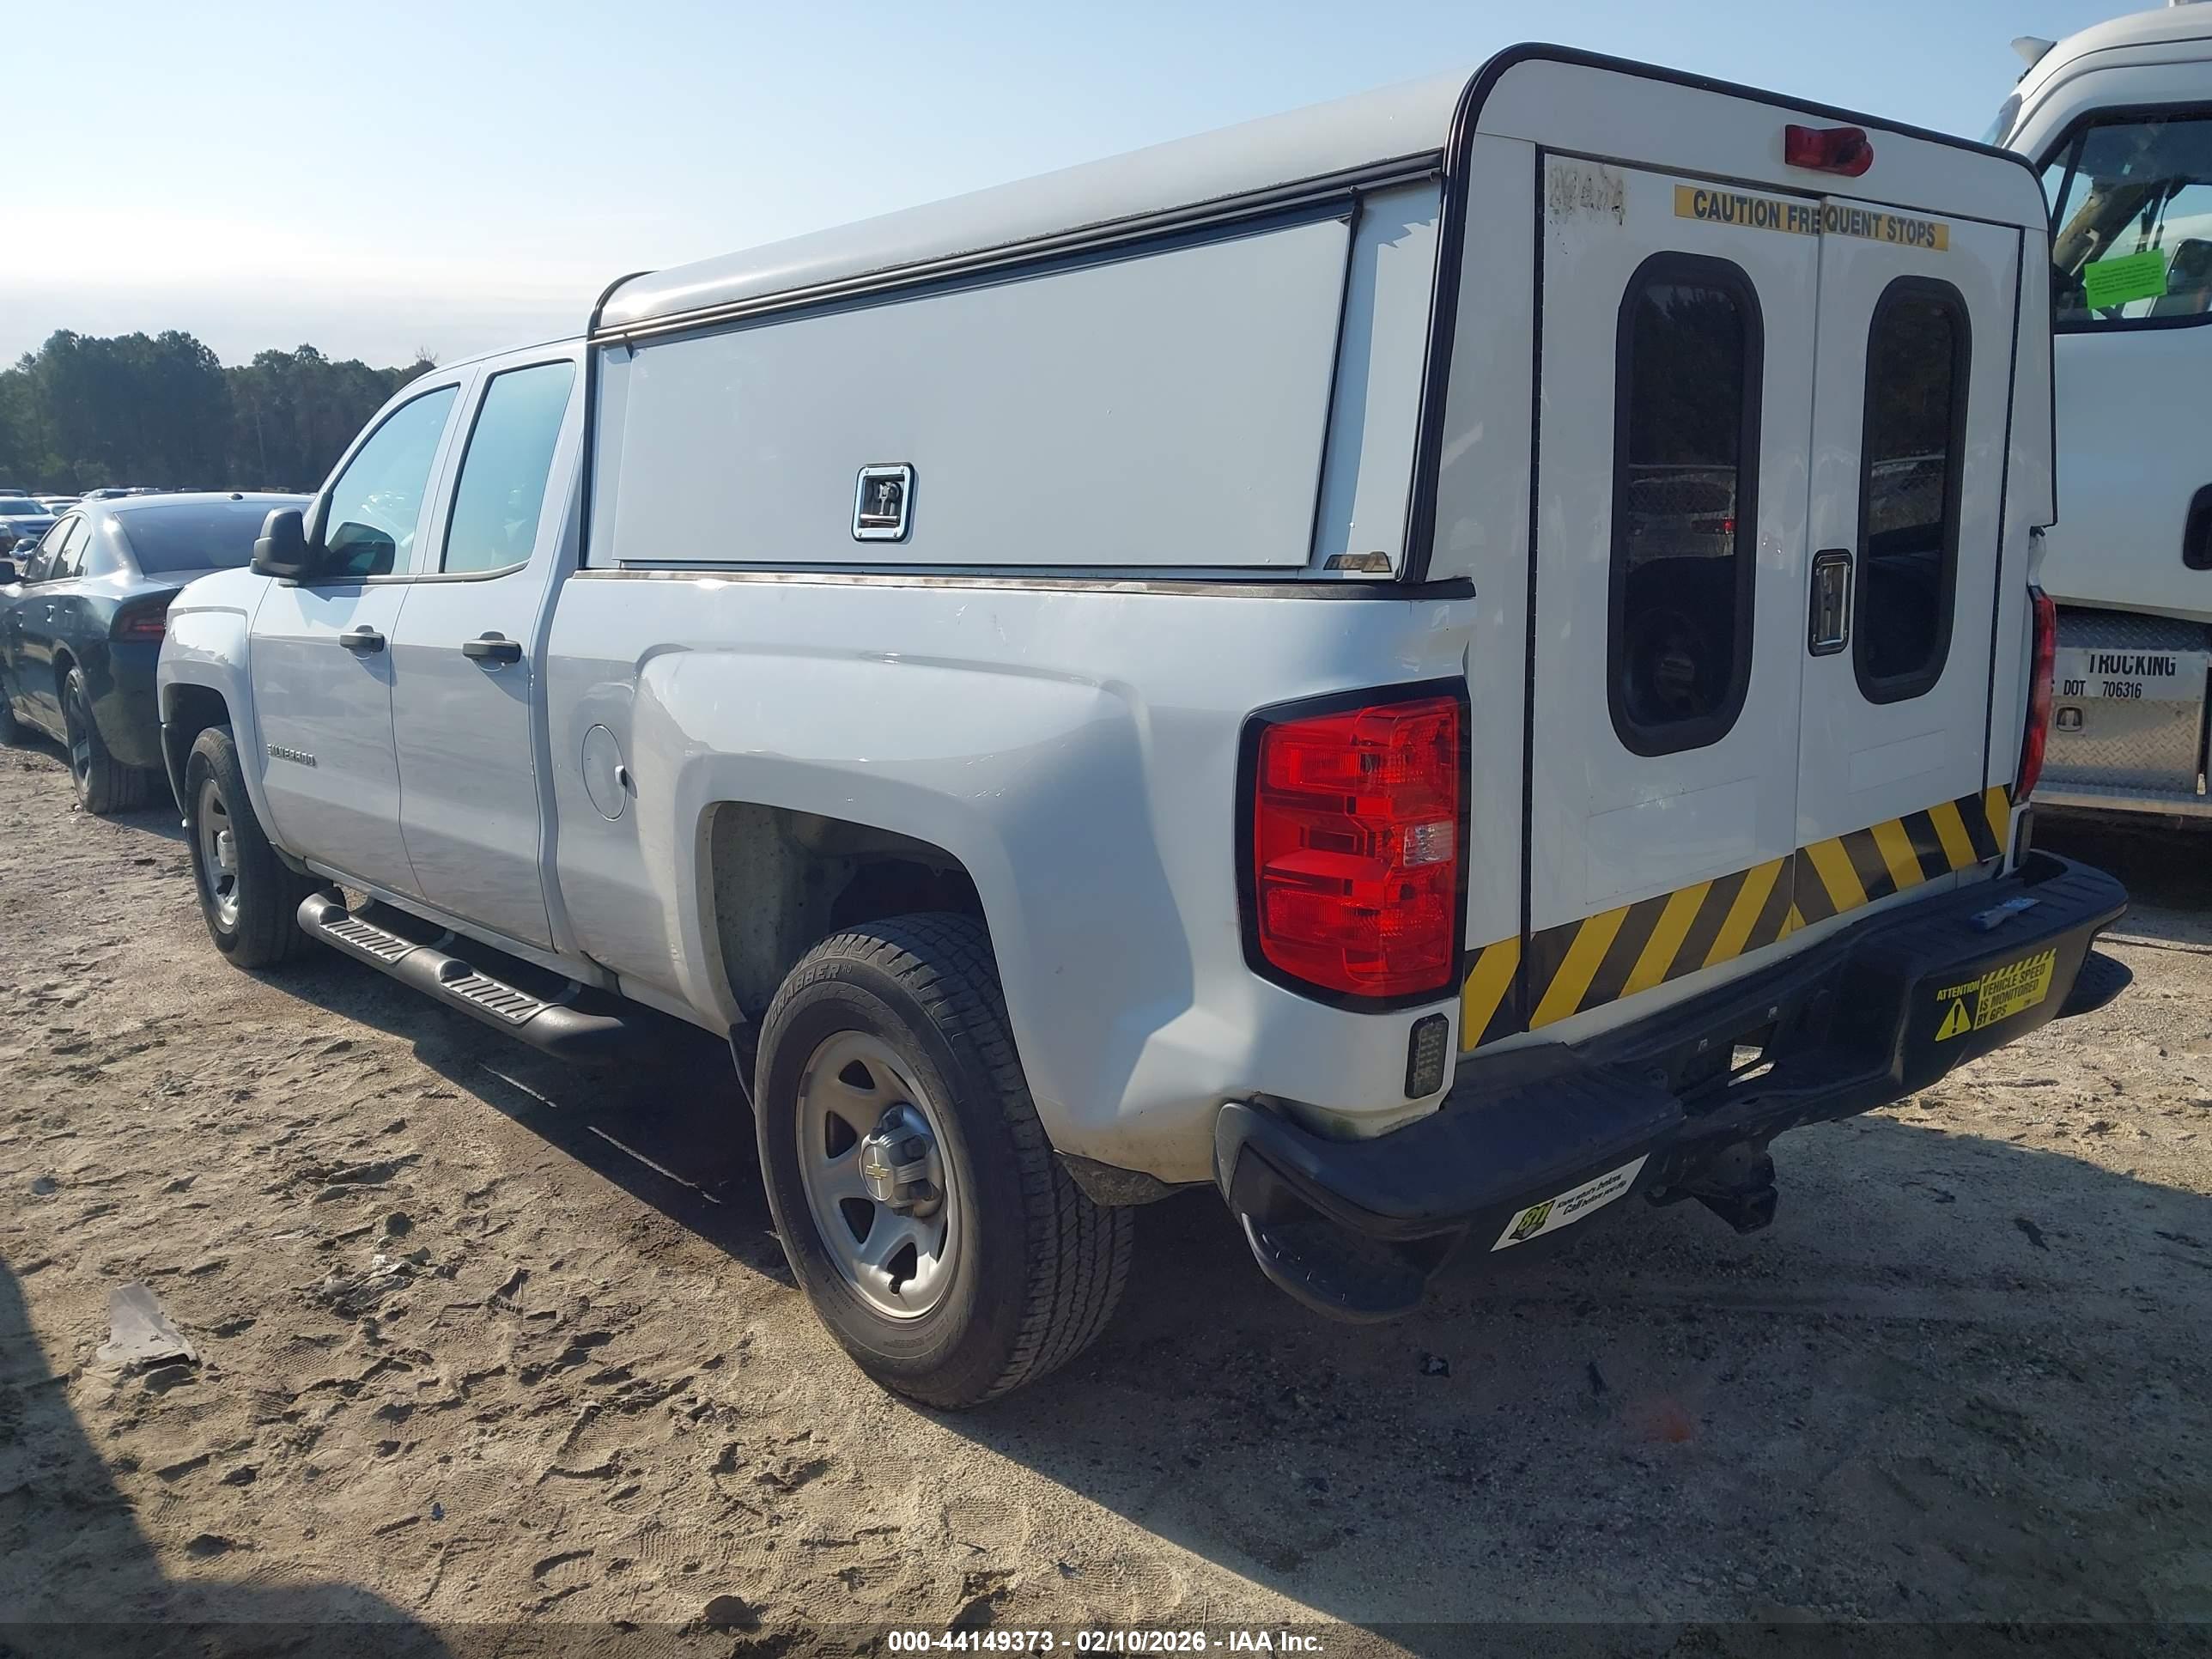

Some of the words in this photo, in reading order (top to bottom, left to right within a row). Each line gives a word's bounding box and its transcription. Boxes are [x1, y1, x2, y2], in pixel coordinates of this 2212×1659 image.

[1693, 190, 1781, 228] CAUTION
[1788, 205, 1882, 237] FREQUENT
[1887, 216, 1936, 247] STOPS
[2063, 680, 2086, 696] DOT
[2103, 681, 2142, 698] 706316
[770, 963, 841, 1028] GRABBER
[1937, 980, 1979, 1001] ATTENTION
[1979, 998, 1989, 1012] IS
[1990, 979, 2039, 1007] MONITORED
[1983, 975, 2018, 997] VEHICLE
[2021, 963, 2045, 984] SPEED
[1977, 1012, 1988, 1026] BY
[1990, 1005, 2008, 1021] GPS
